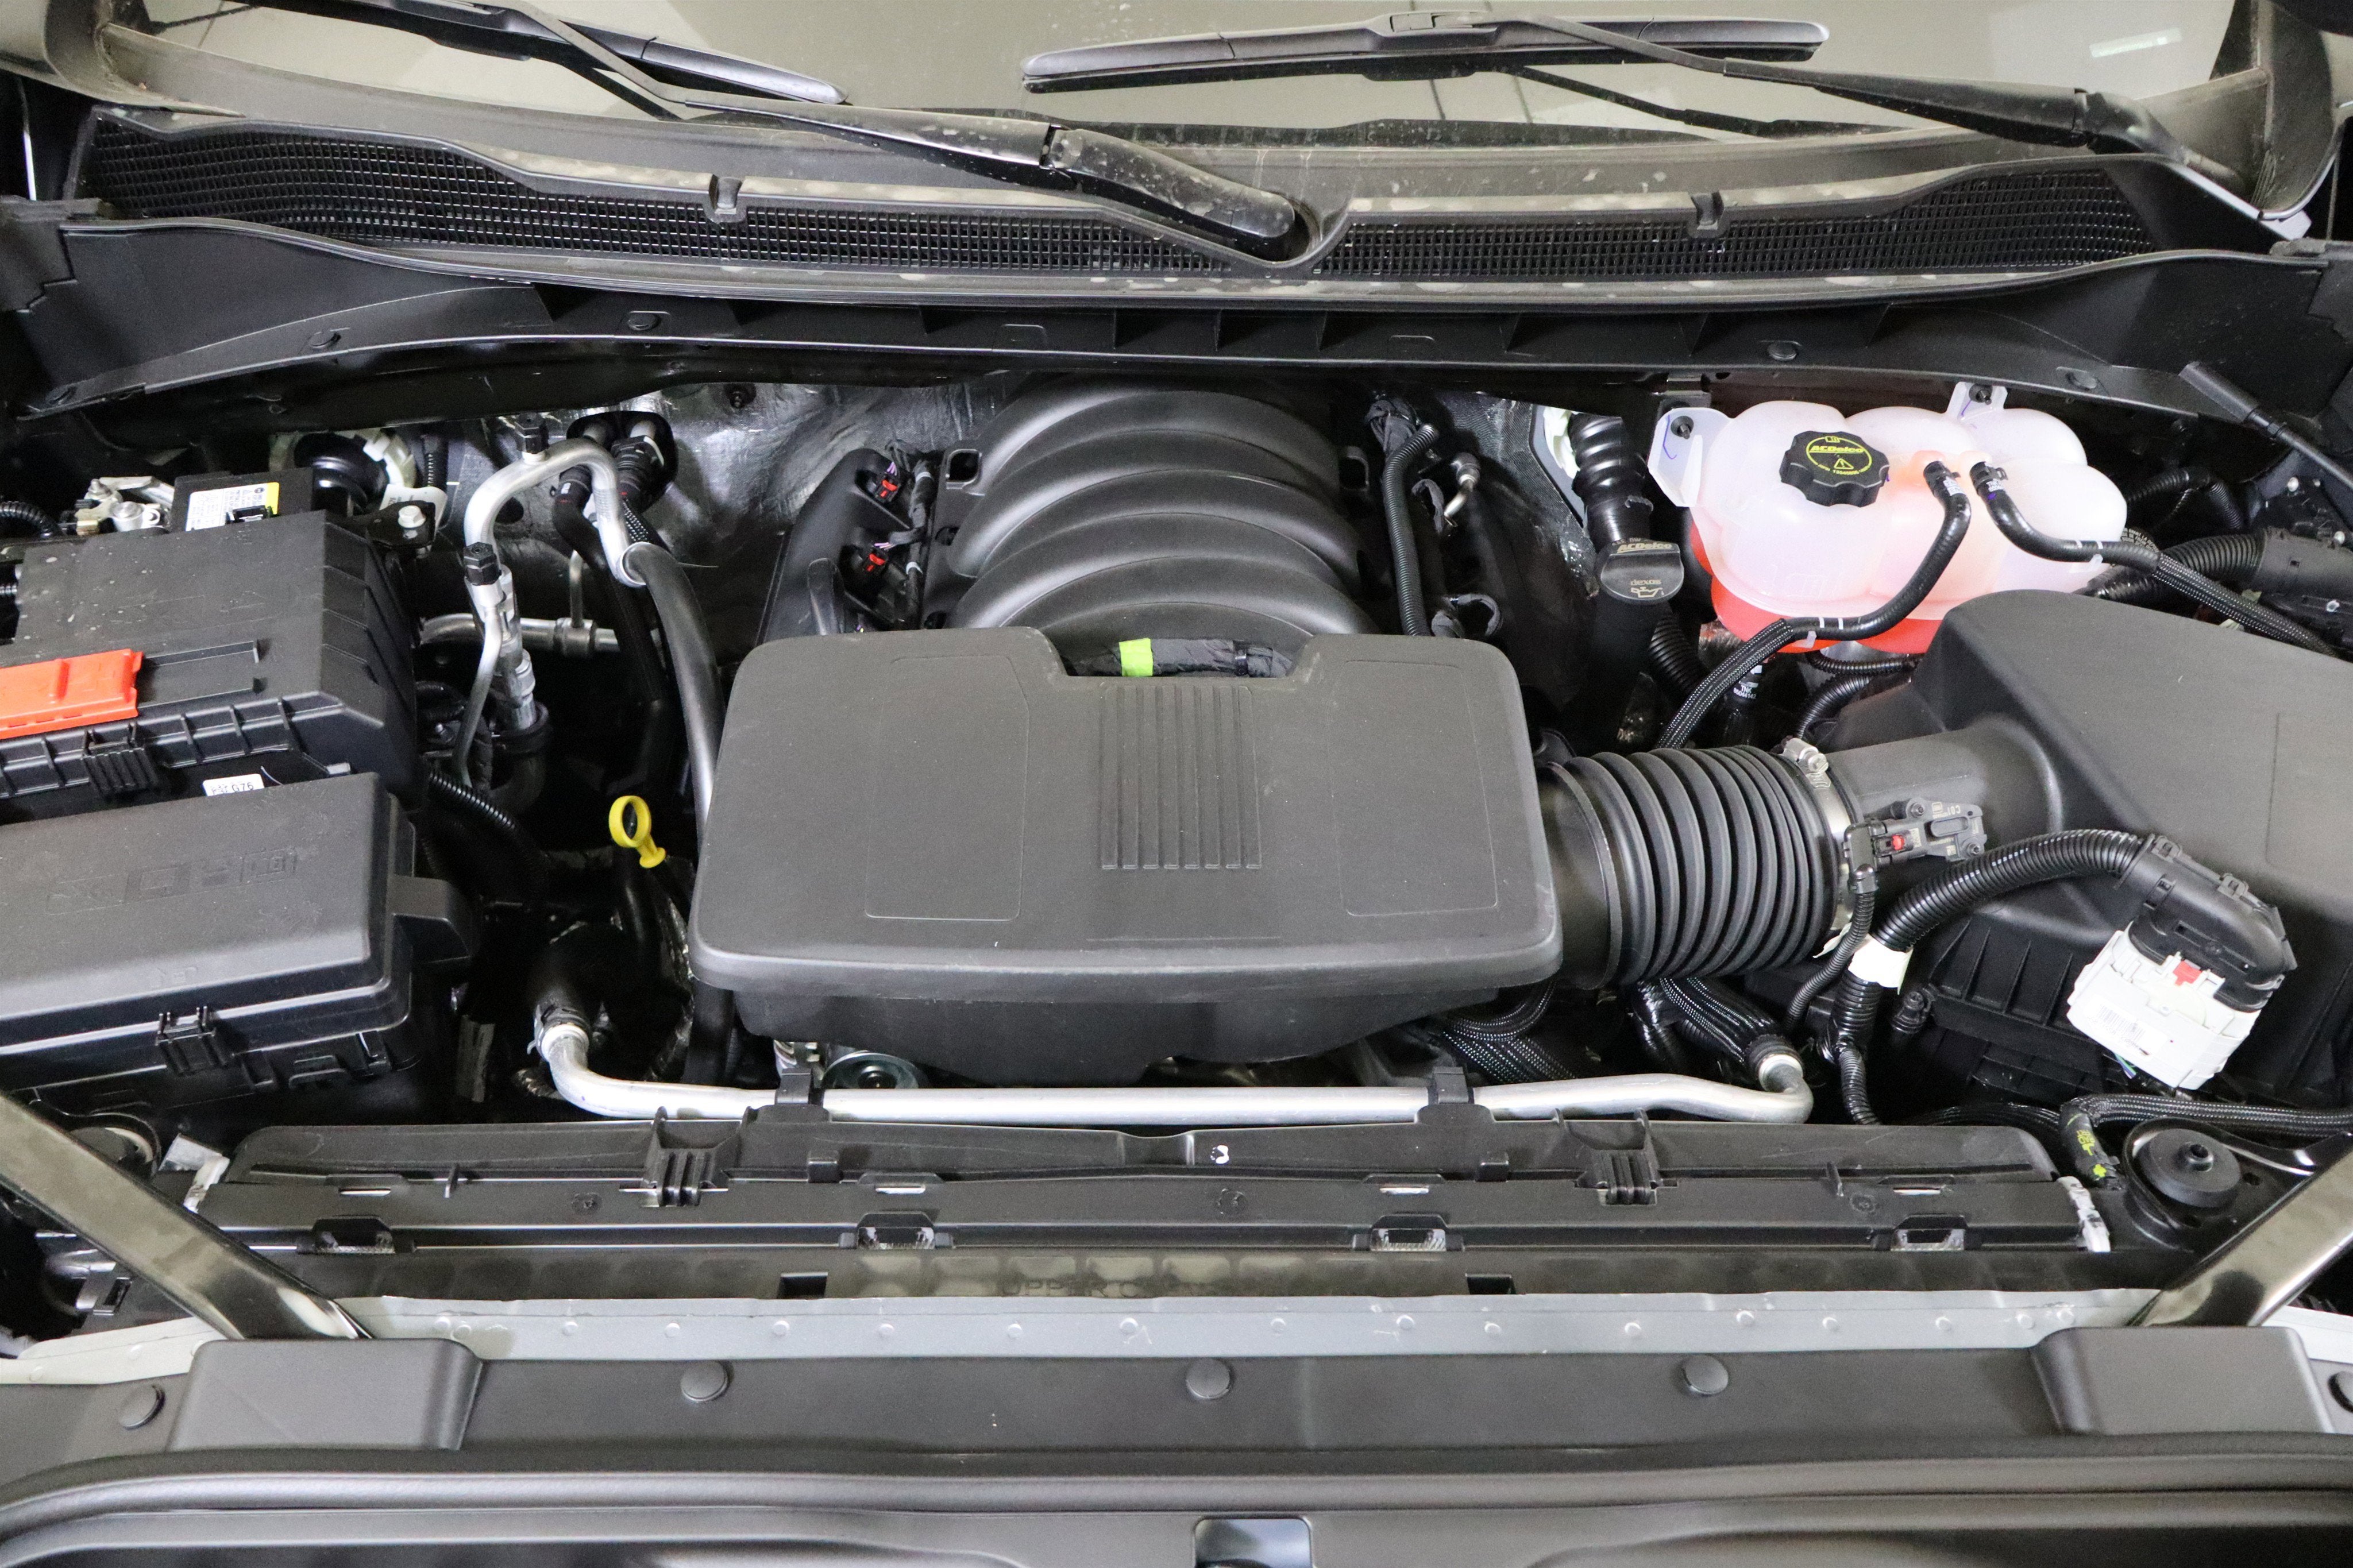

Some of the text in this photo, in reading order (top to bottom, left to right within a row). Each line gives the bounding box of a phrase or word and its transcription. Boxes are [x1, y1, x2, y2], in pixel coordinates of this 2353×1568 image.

[1810, 445, 1865, 453] ACDelco
[1617, 542, 1672, 553] ACDelco
[232, 782, 254, 793] G76
